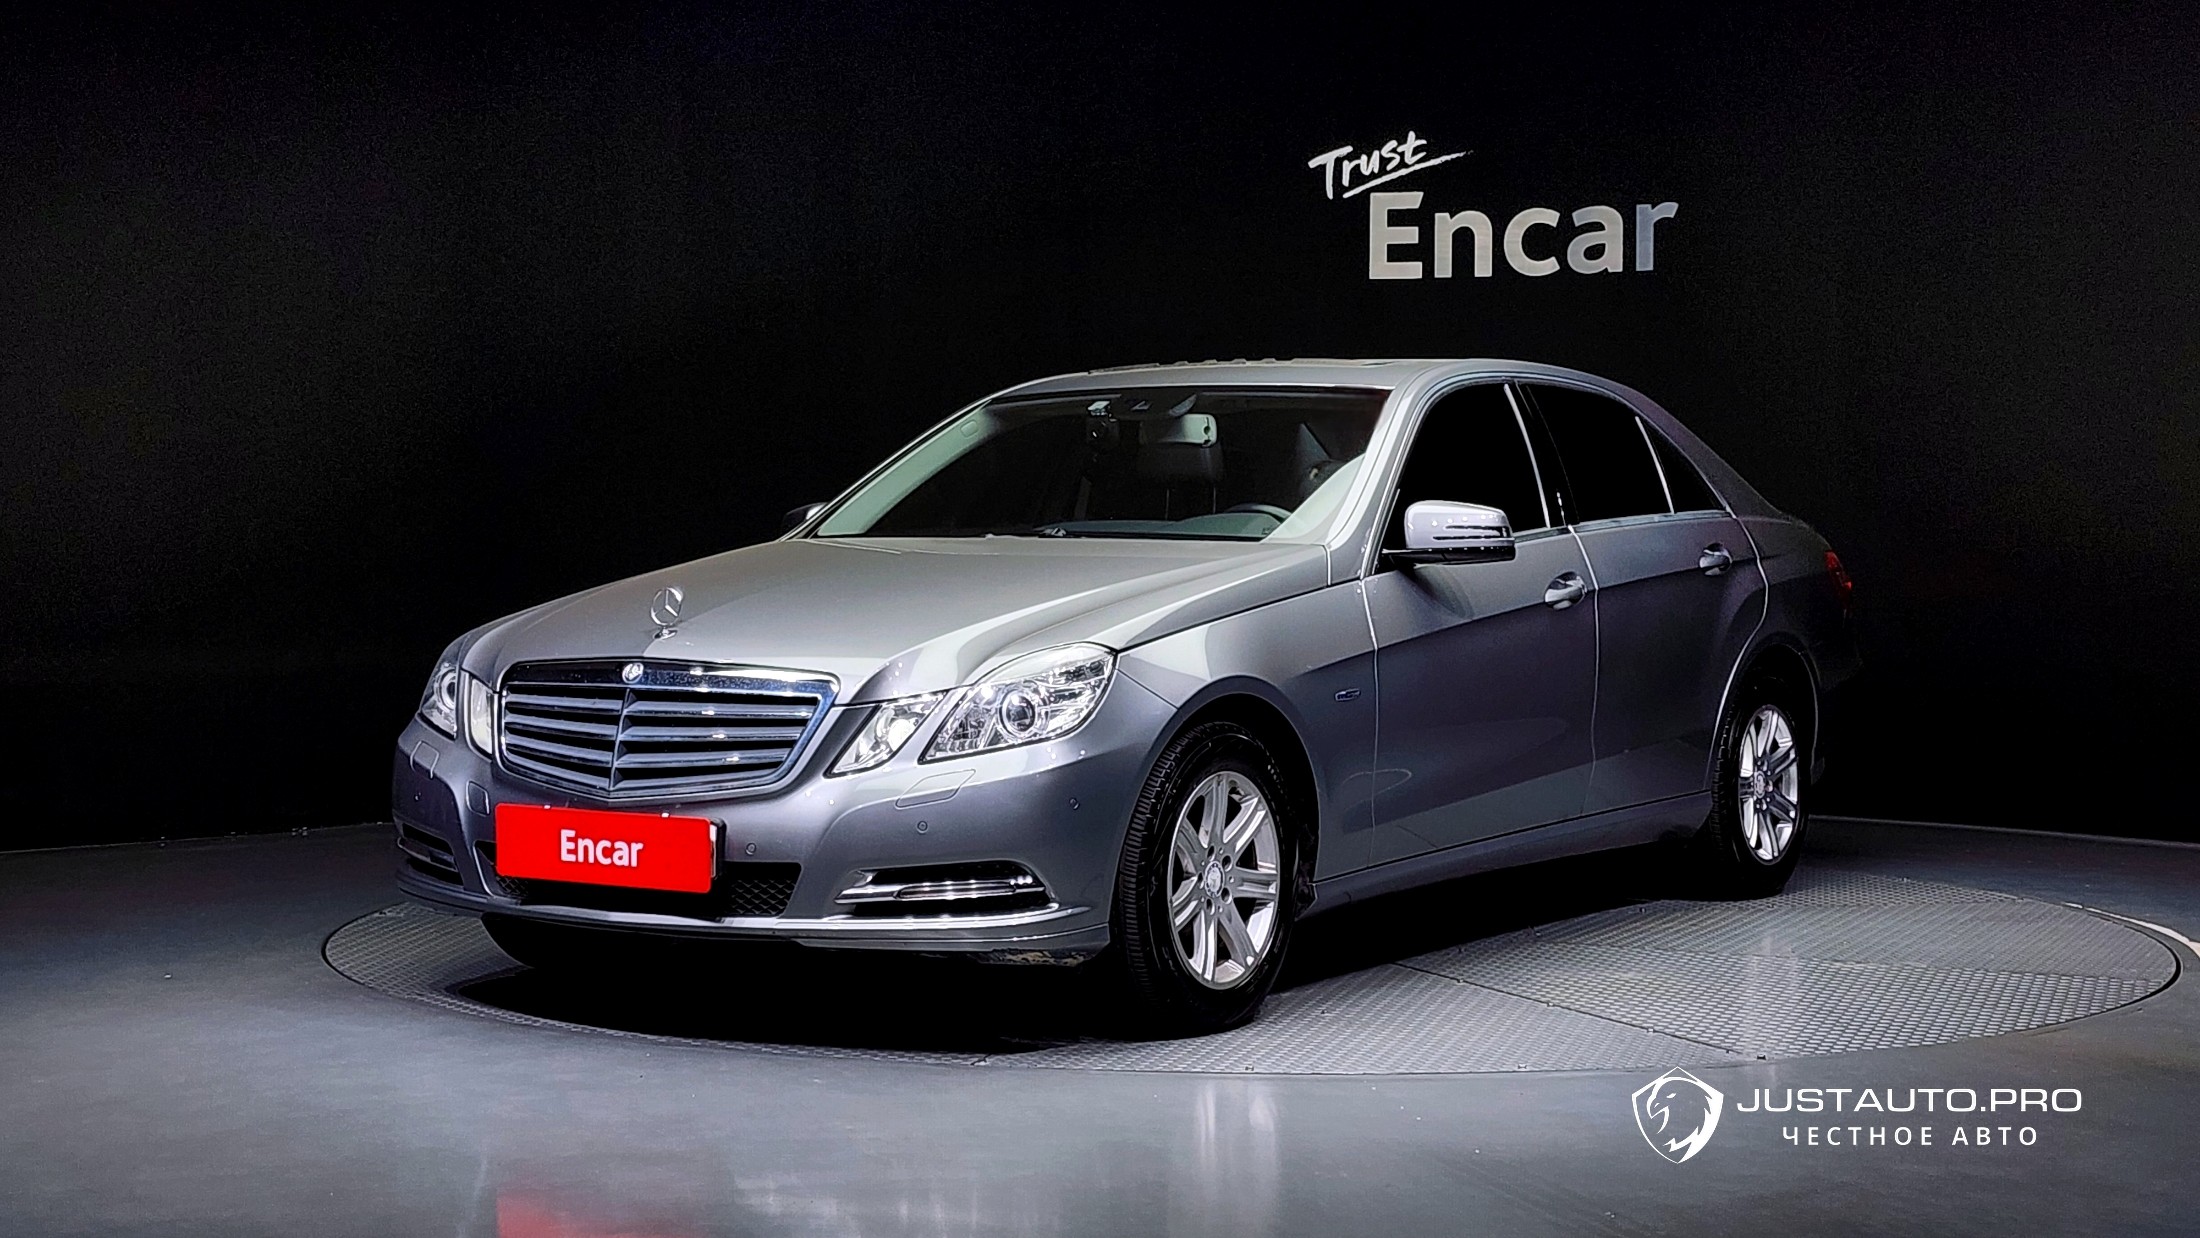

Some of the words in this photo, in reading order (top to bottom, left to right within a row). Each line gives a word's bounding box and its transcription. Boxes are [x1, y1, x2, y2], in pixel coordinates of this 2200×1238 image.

[1308, 131, 1427, 200] Trust
[1369, 191, 1679, 280] Encar
[560, 828, 644, 868] Encar
